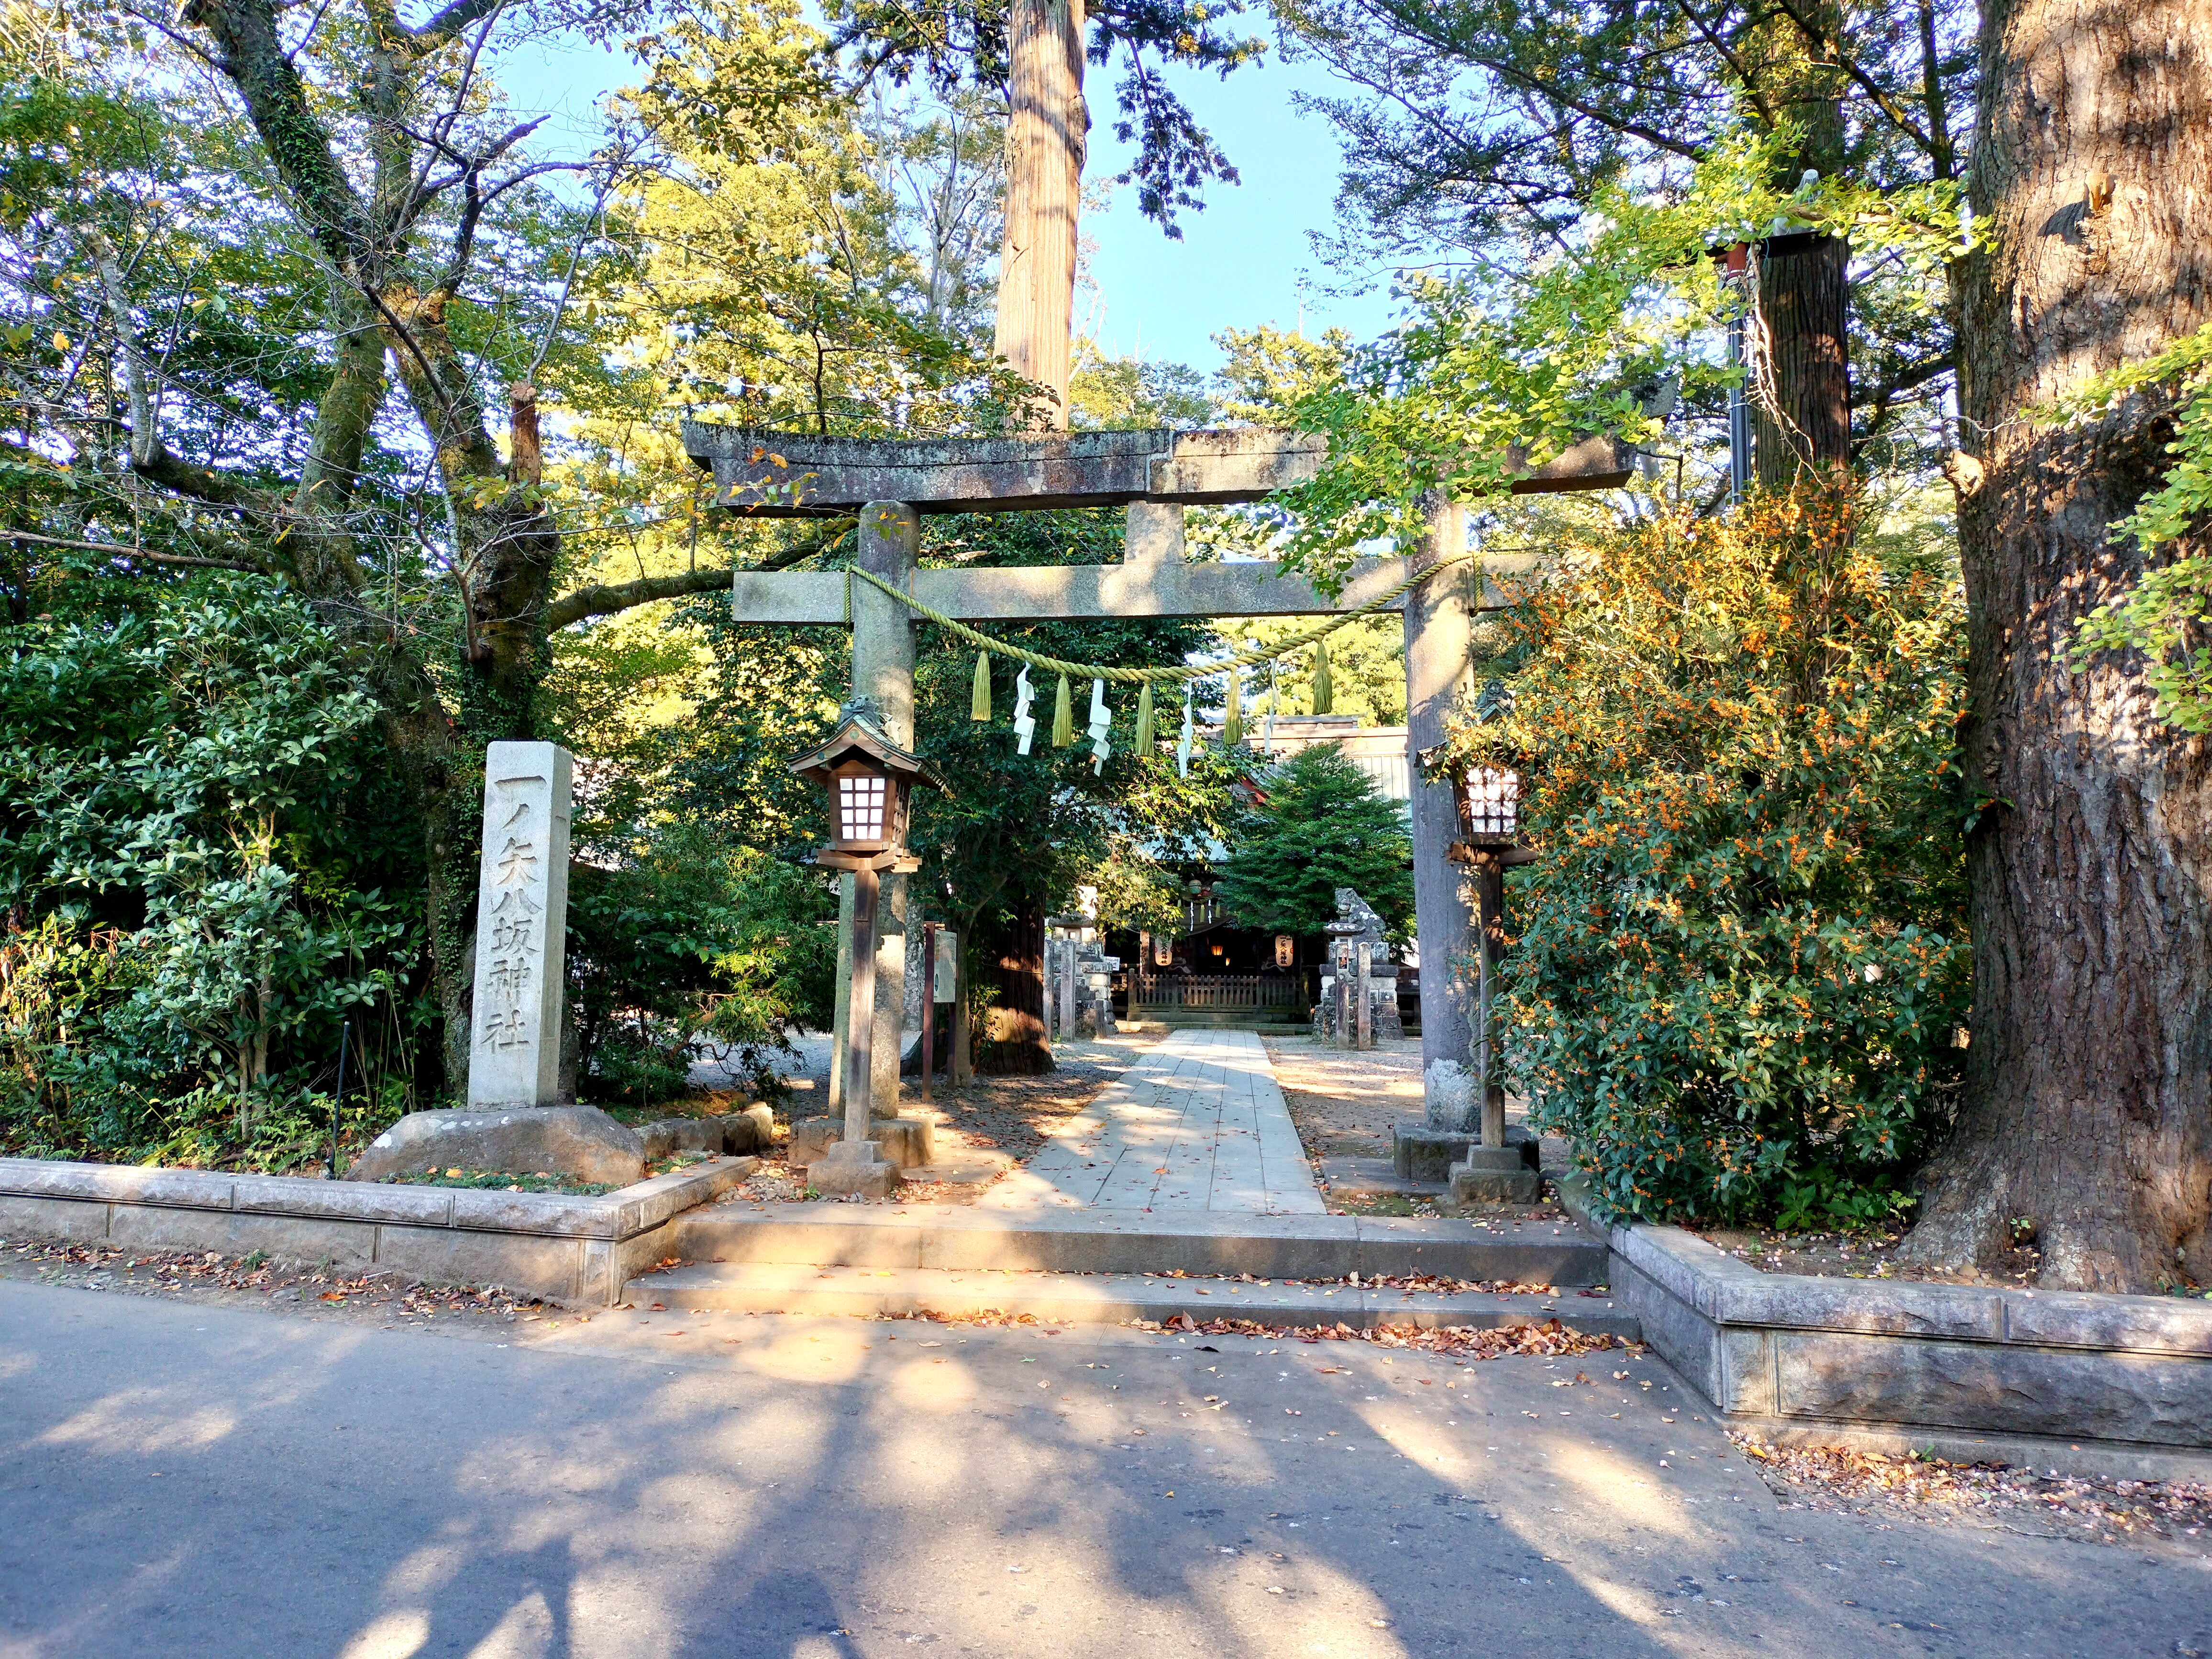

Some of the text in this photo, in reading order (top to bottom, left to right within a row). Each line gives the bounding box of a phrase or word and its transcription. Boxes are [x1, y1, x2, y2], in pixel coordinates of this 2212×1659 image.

[480, 775, 547, 1054] 一ノ矢八坂神社
